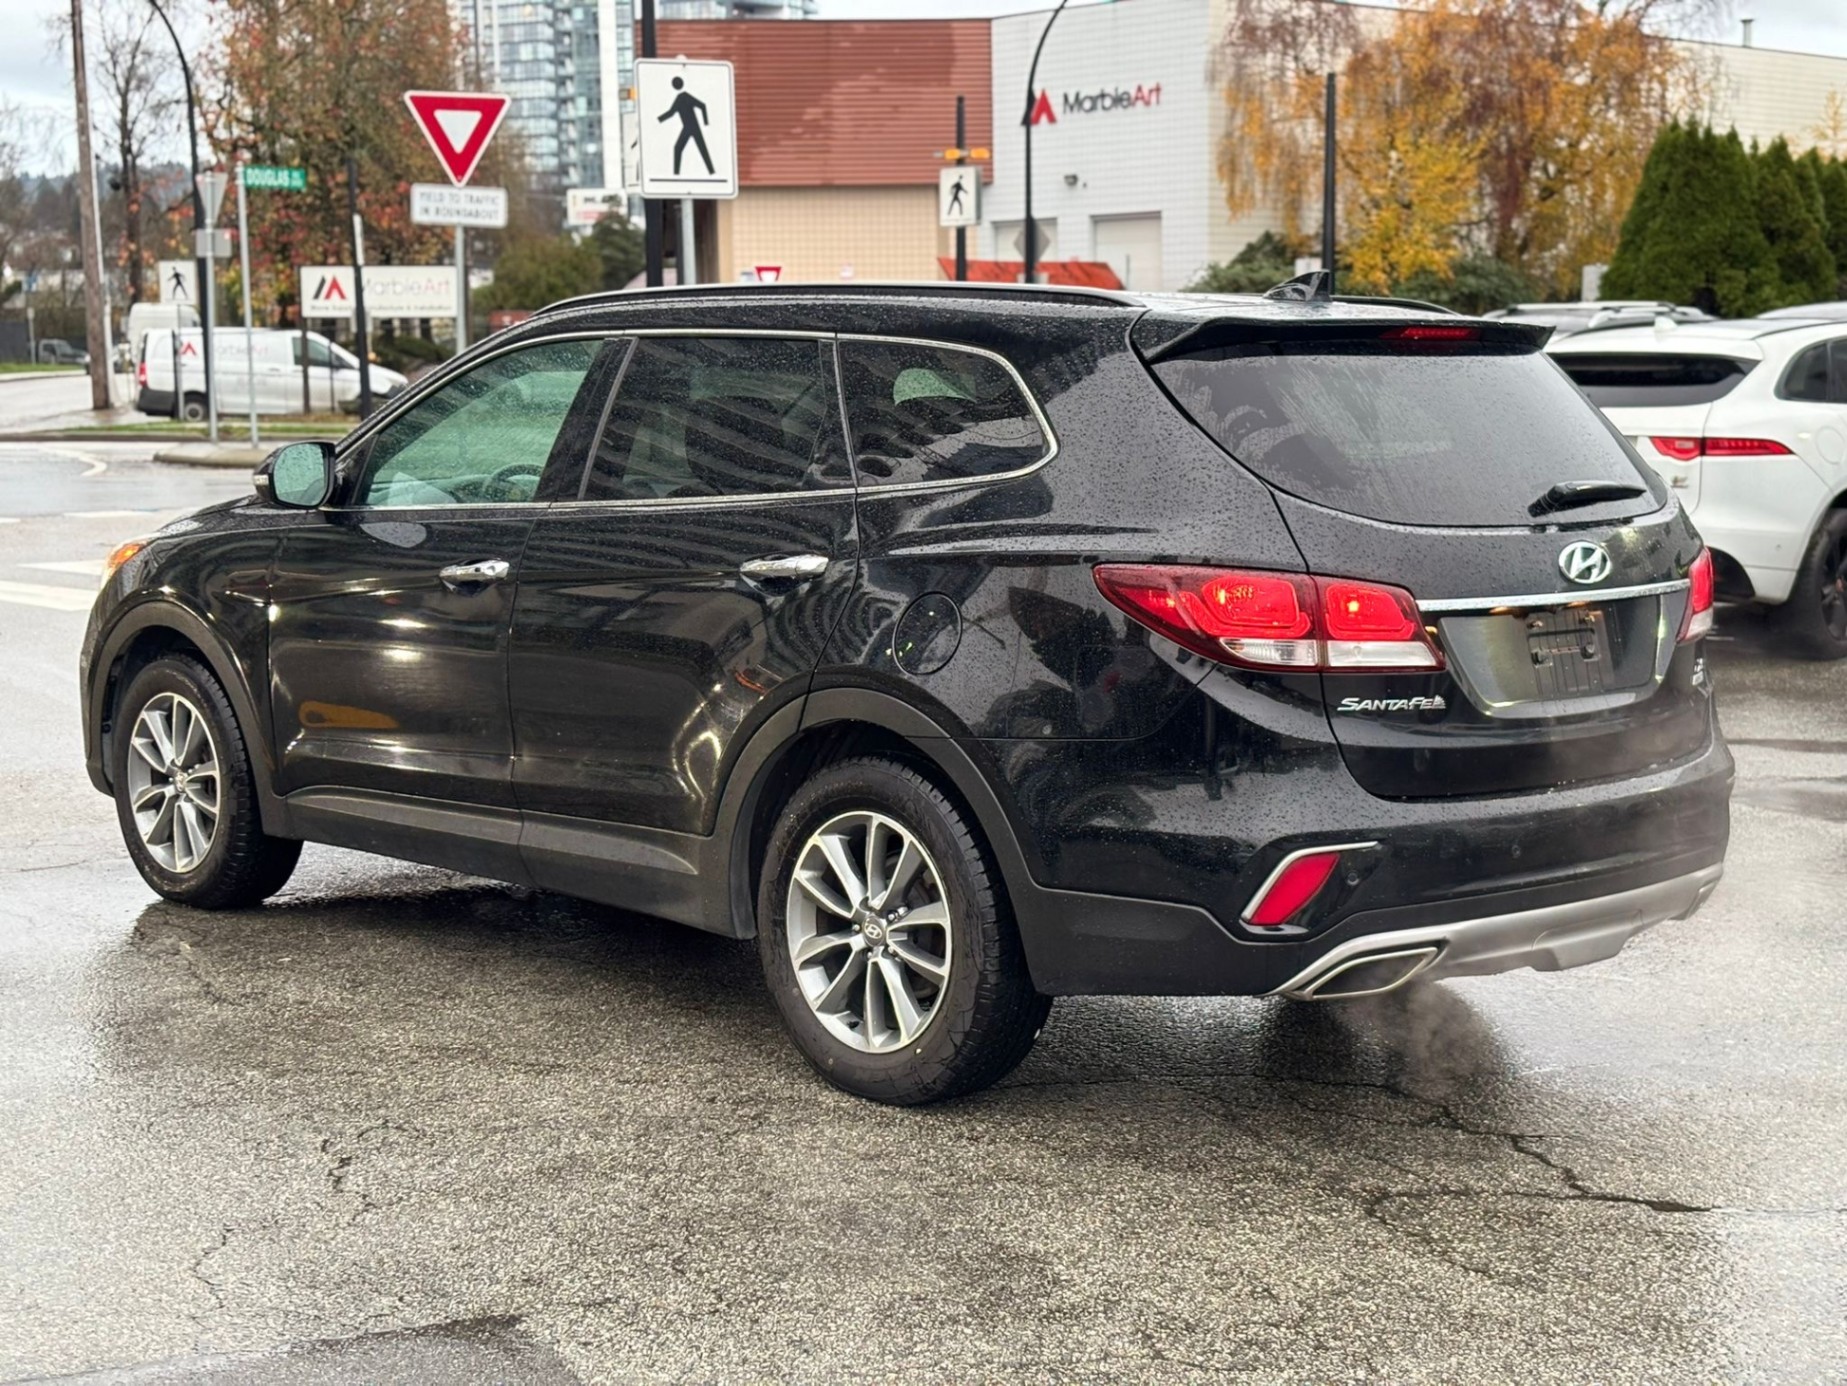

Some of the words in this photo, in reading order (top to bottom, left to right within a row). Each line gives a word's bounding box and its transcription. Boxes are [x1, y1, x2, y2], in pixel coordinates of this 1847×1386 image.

[1063, 83, 1161, 114] MarbleArt
[246, 168, 289, 186] DOUGLAS
[419, 192, 444, 203] YIELD
[448, 193, 460, 203] TO
[464, 193, 499, 206] TRAFFIC
[435, 207, 499, 219] ROUNDABOUT
